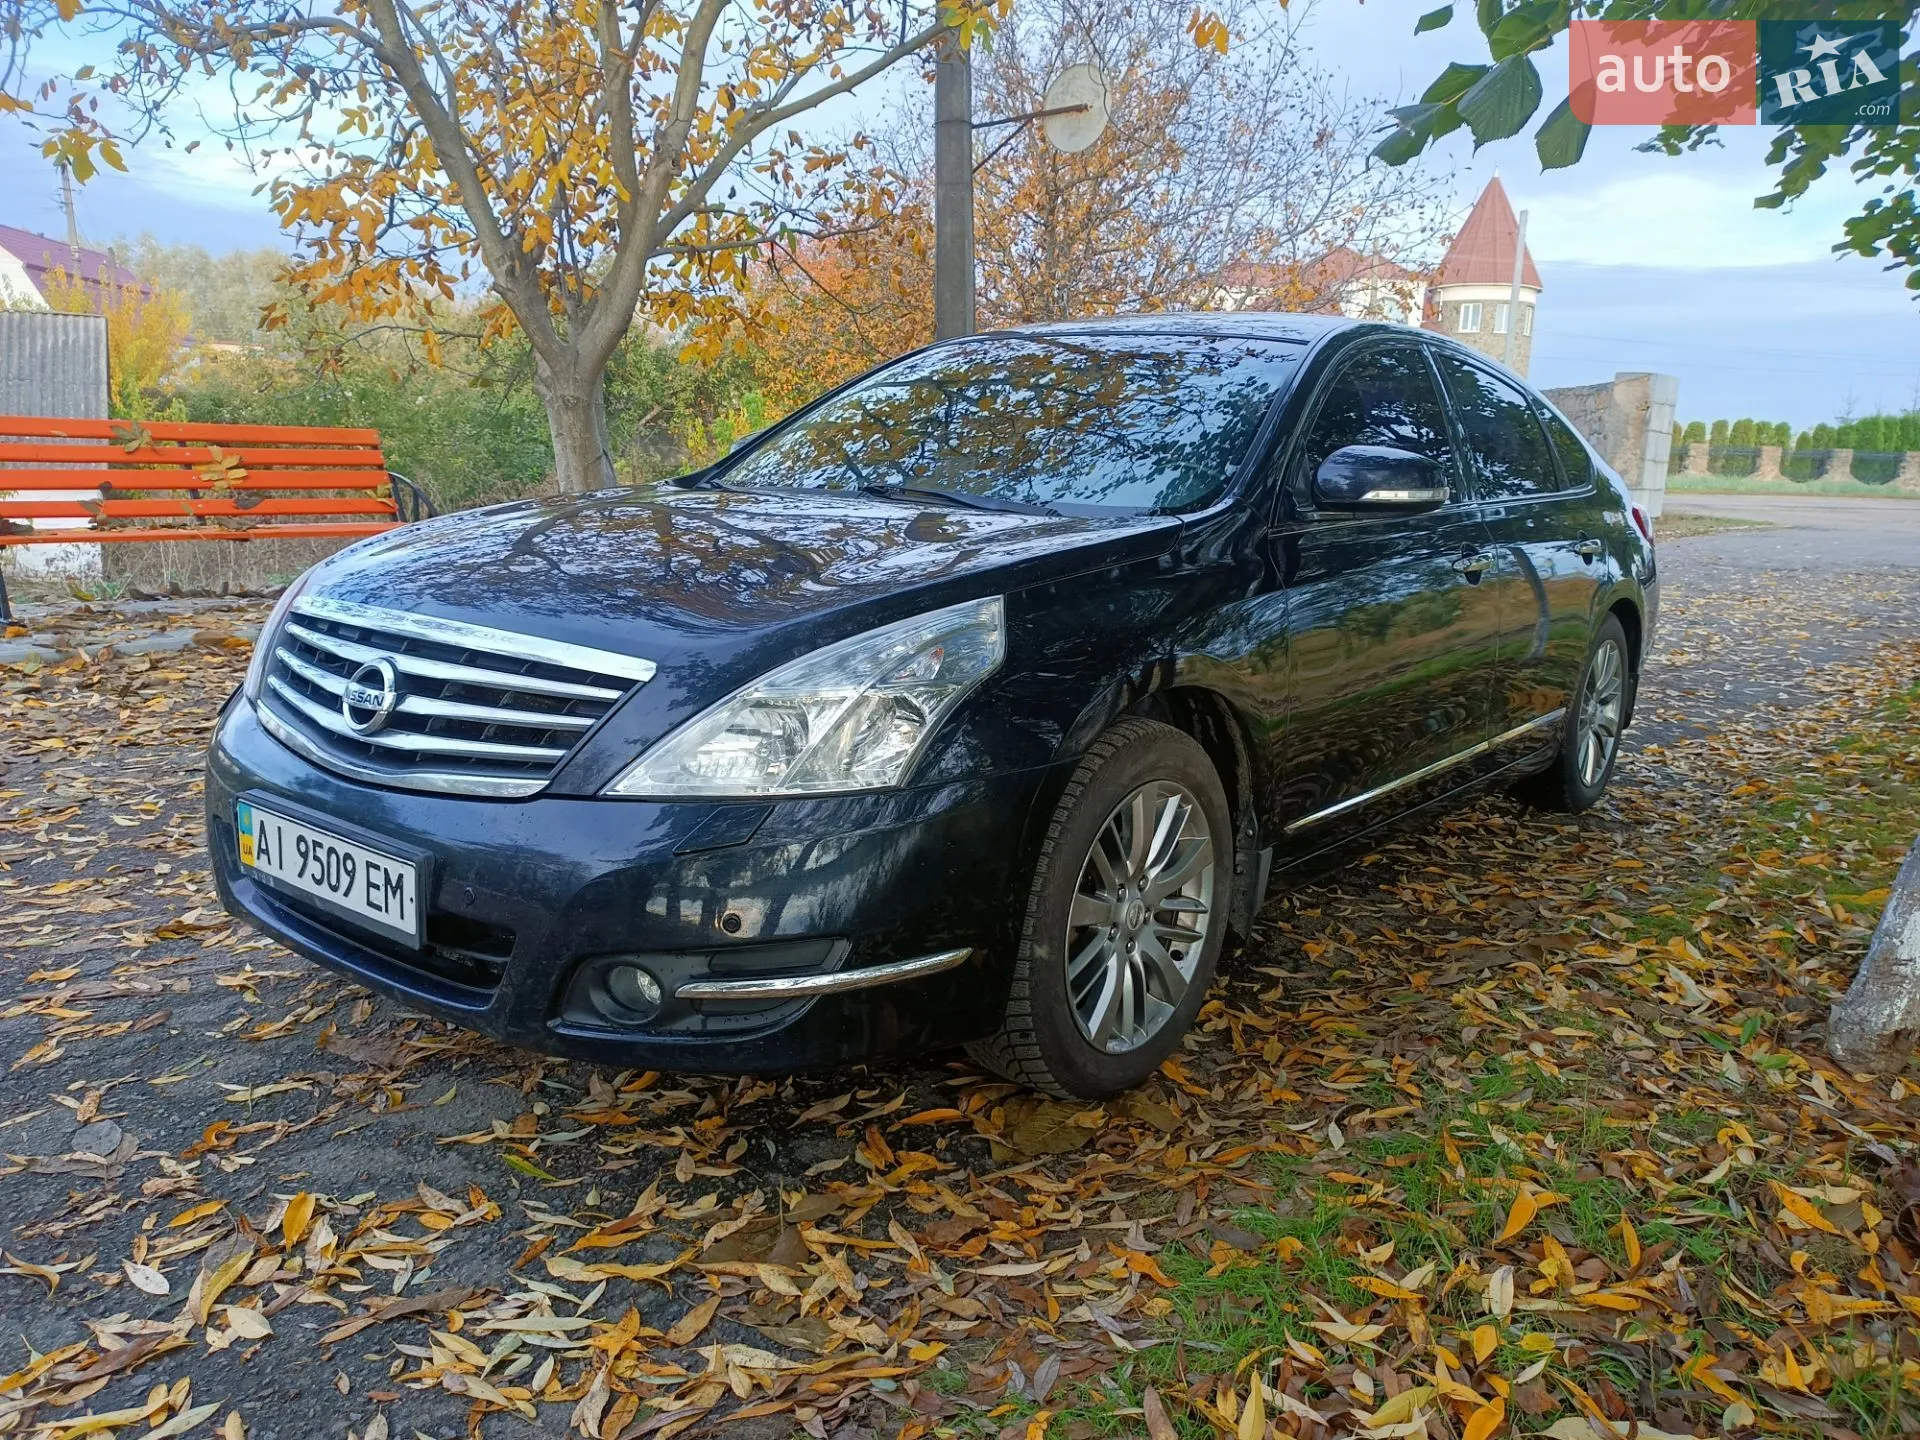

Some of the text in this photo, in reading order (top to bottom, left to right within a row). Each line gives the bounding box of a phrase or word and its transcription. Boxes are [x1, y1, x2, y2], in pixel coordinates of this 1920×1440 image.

[350, 690, 384, 706] SSAN
[242, 843, 253, 857] UA
[257, 820, 404, 920] AI 9509 EM
